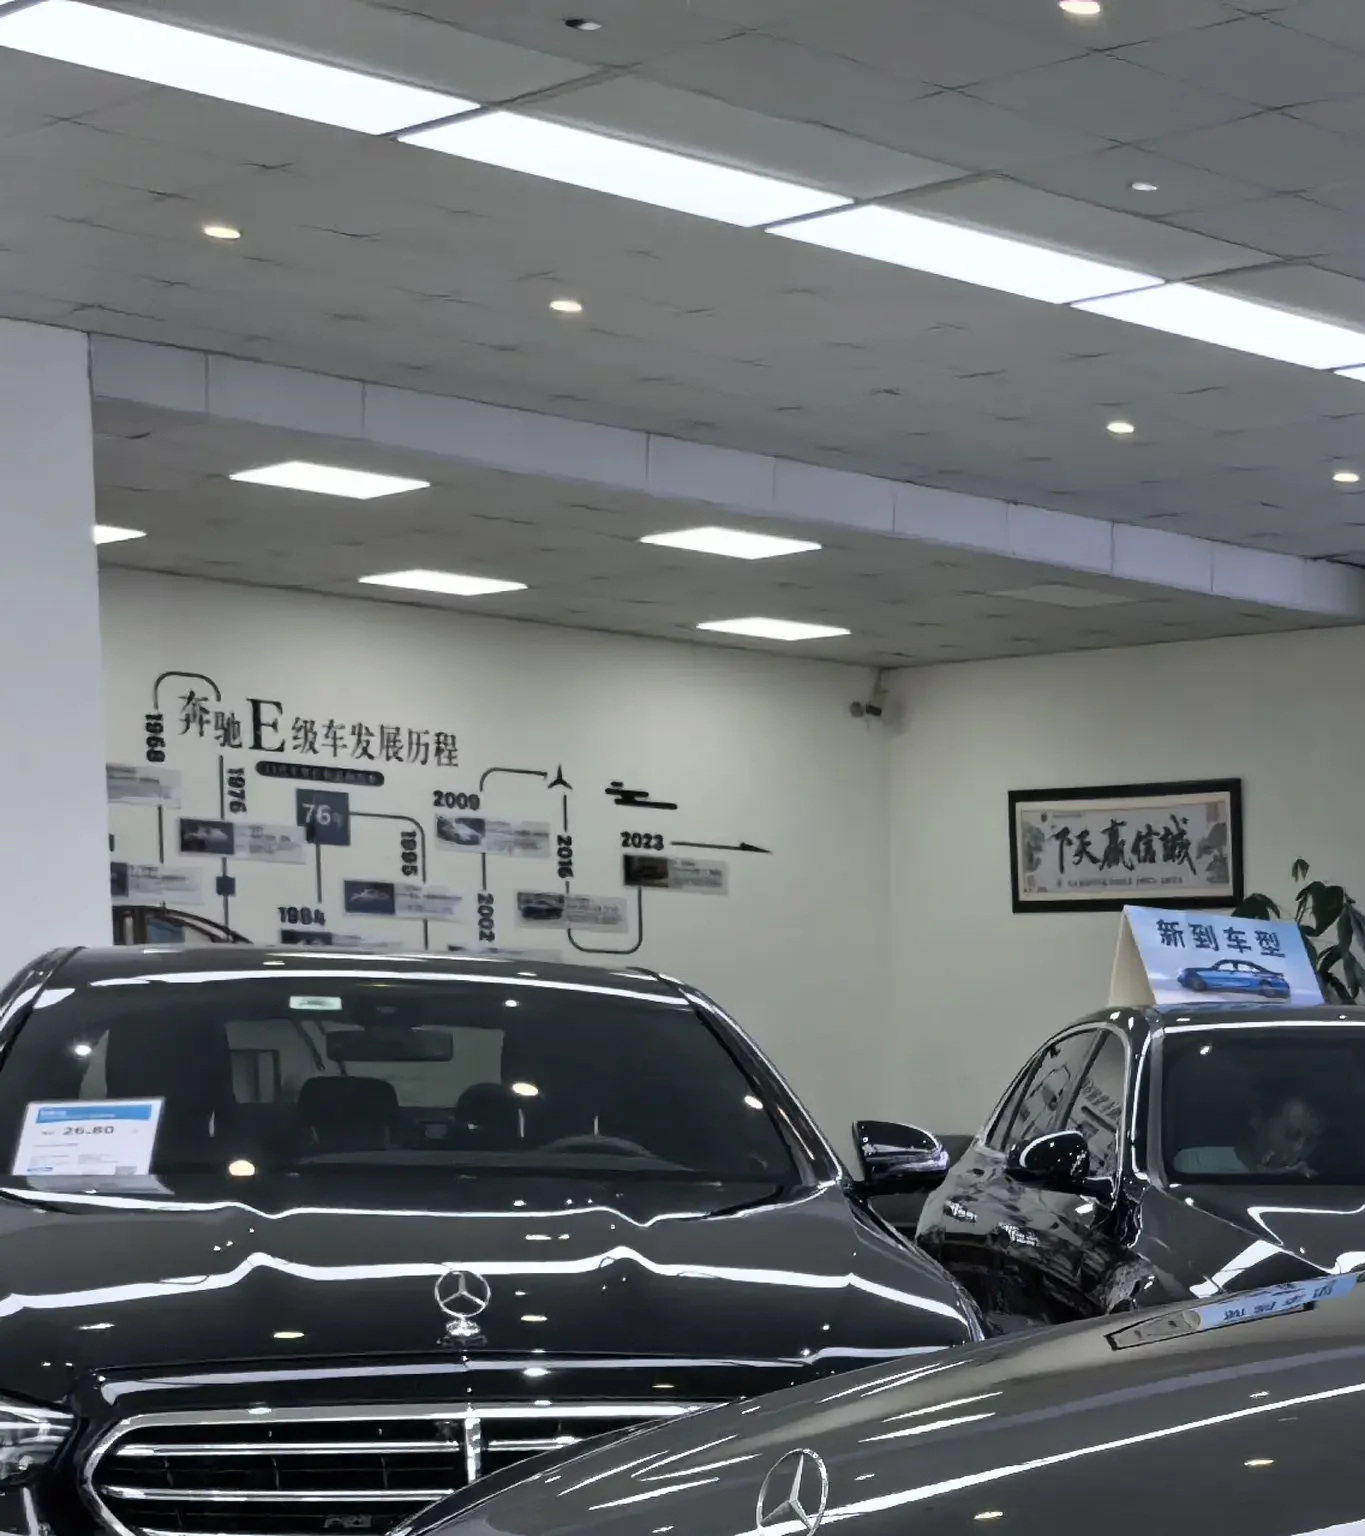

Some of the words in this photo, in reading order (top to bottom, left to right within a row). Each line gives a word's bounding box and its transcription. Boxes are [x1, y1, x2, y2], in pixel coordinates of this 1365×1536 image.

[177, 687, 459, 767] 奔驰E级车发展历程
[556, 834, 574, 879] 2016
[620, 831, 664, 851] 2023
[477, 892, 496, 943] 2002
[1156, 918, 1286, 958] 新到车型
